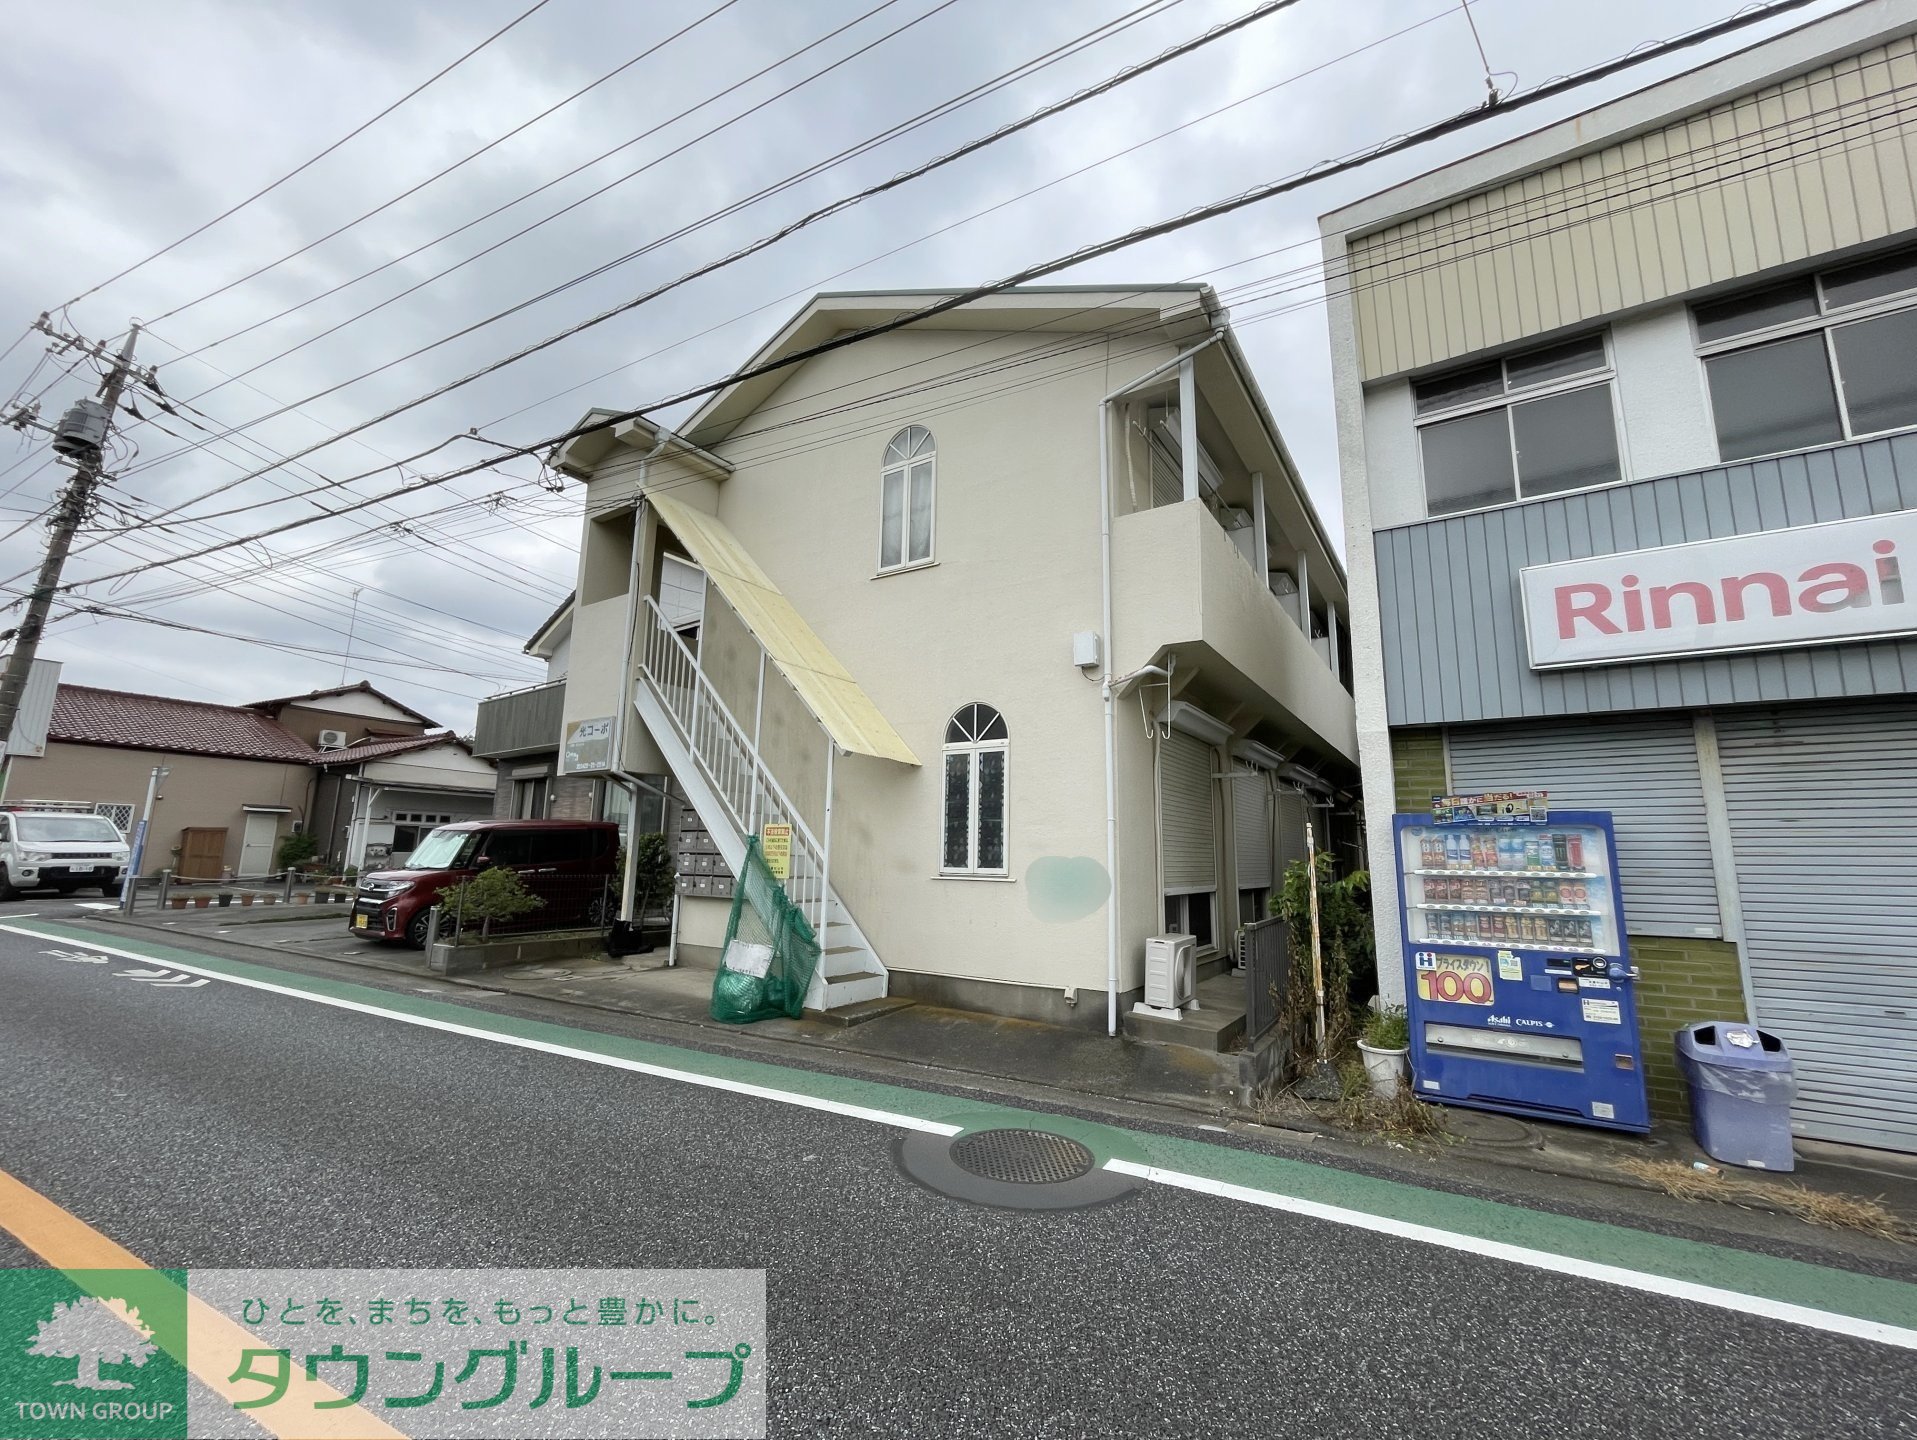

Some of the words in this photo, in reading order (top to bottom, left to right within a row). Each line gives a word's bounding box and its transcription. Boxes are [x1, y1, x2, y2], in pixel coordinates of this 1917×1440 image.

[1554, 540, 1905, 640] Rinnai
[1421, 971, 1492, 1004] 100
[1487, 1014, 1511, 1025] Asahi
[1515, 1018, 1543, 1027] CALPIS
